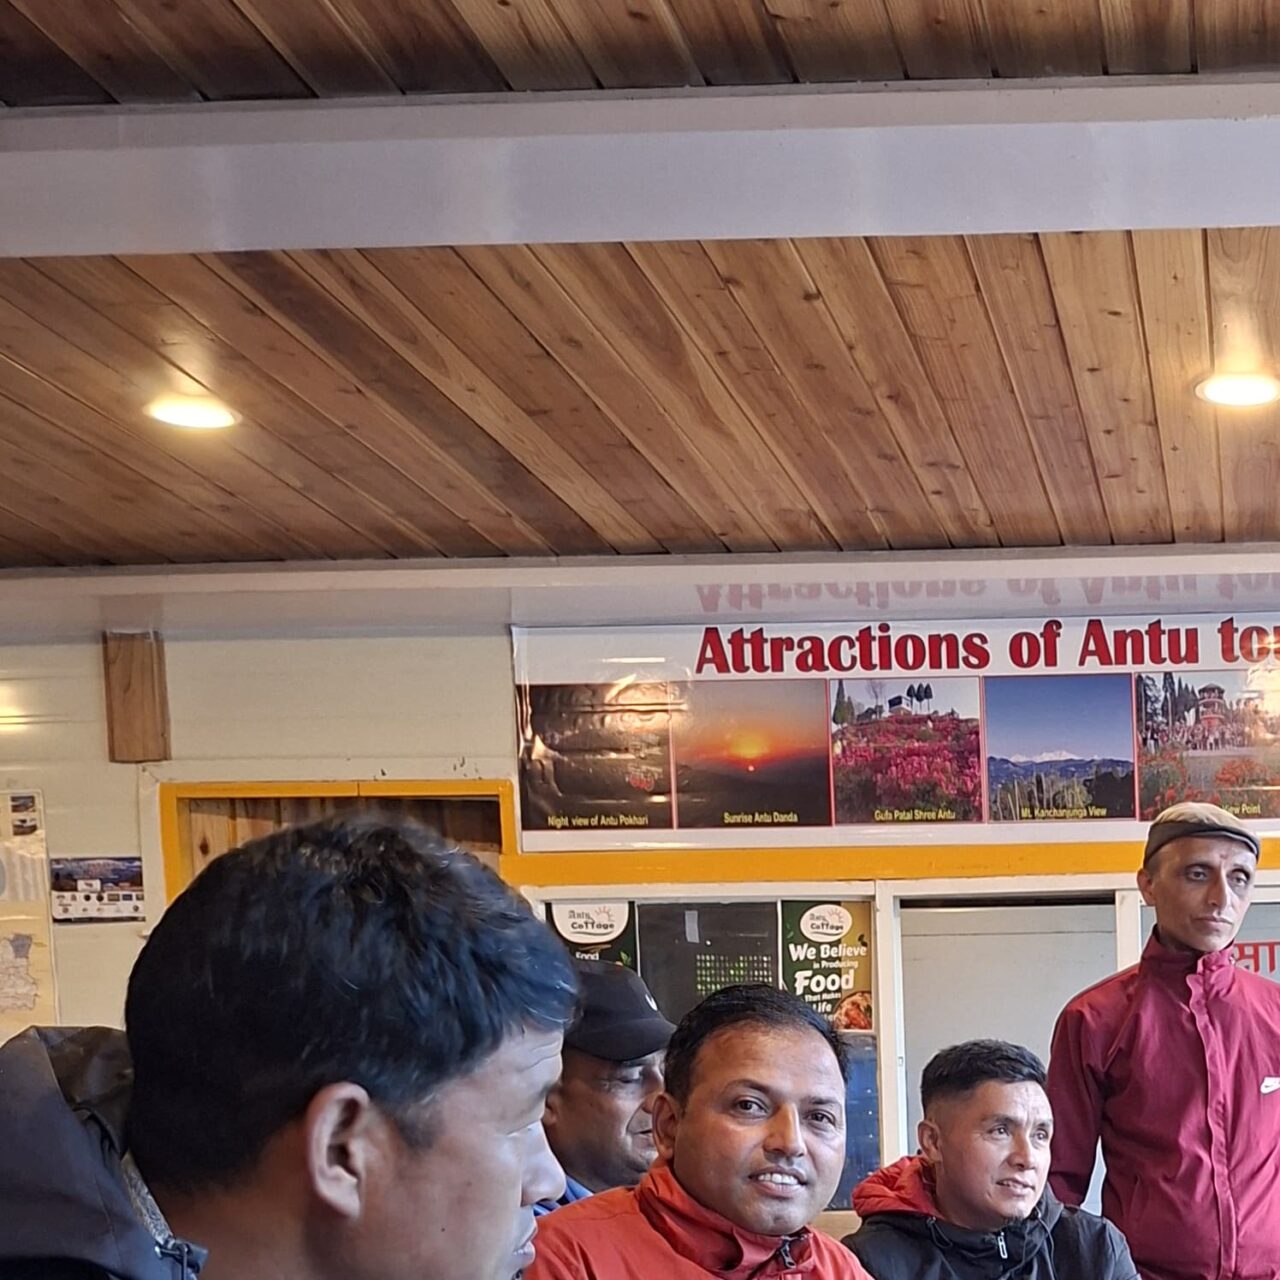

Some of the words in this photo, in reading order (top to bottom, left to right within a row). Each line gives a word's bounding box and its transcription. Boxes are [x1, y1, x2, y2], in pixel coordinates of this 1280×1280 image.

[695, 622, 991, 674] Attractions
[1008, 619, 1063, 668] of
[1078, 617, 1200, 667] Antu
[914, 809, 936, 820] Shree
[937, 808, 956, 820] Antu
[1088, 805, 1107, 816] View
[1241, 803, 1261, 814] Point
[547, 815, 569, 829] Night
[572, 815, 589, 826] view
[590, 814, 598, 826] of
[600, 814, 618, 826] Antu
[619, 814, 649, 826] Pokhari
[723, 811, 753, 823] Sunrise
[754, 811, 772, 823] Antu
[773, 811, 798, 823] Danda
[788, 943, 817, 962] We
[819, 943, 867, 959] Believe
[794, 969, 855, 996] Food
